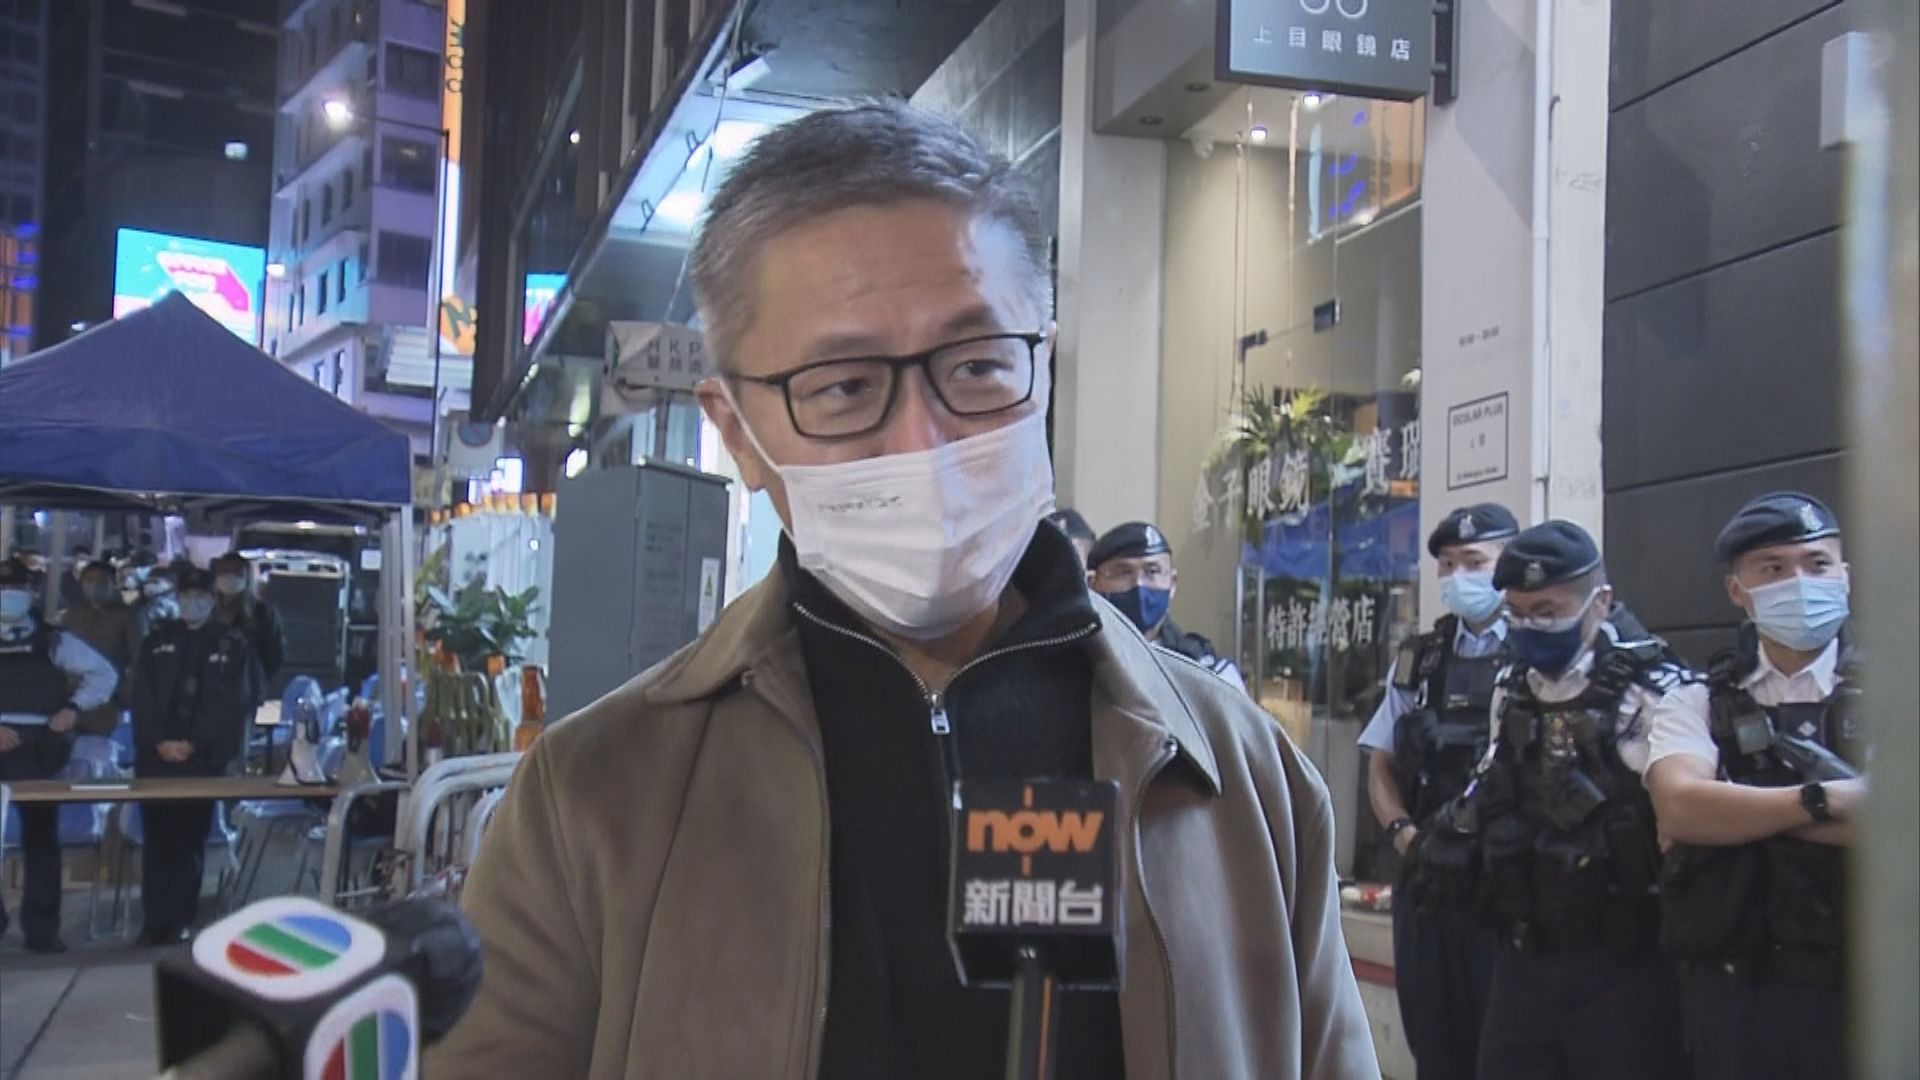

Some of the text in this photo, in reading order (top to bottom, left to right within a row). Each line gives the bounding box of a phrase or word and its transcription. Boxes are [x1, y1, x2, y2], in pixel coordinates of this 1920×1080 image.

[1252, 24, 1410, 61] 上目眼鏡店
[967, 810, 1104, 853] now
[963, 878, 1103, 926] 新聞台
